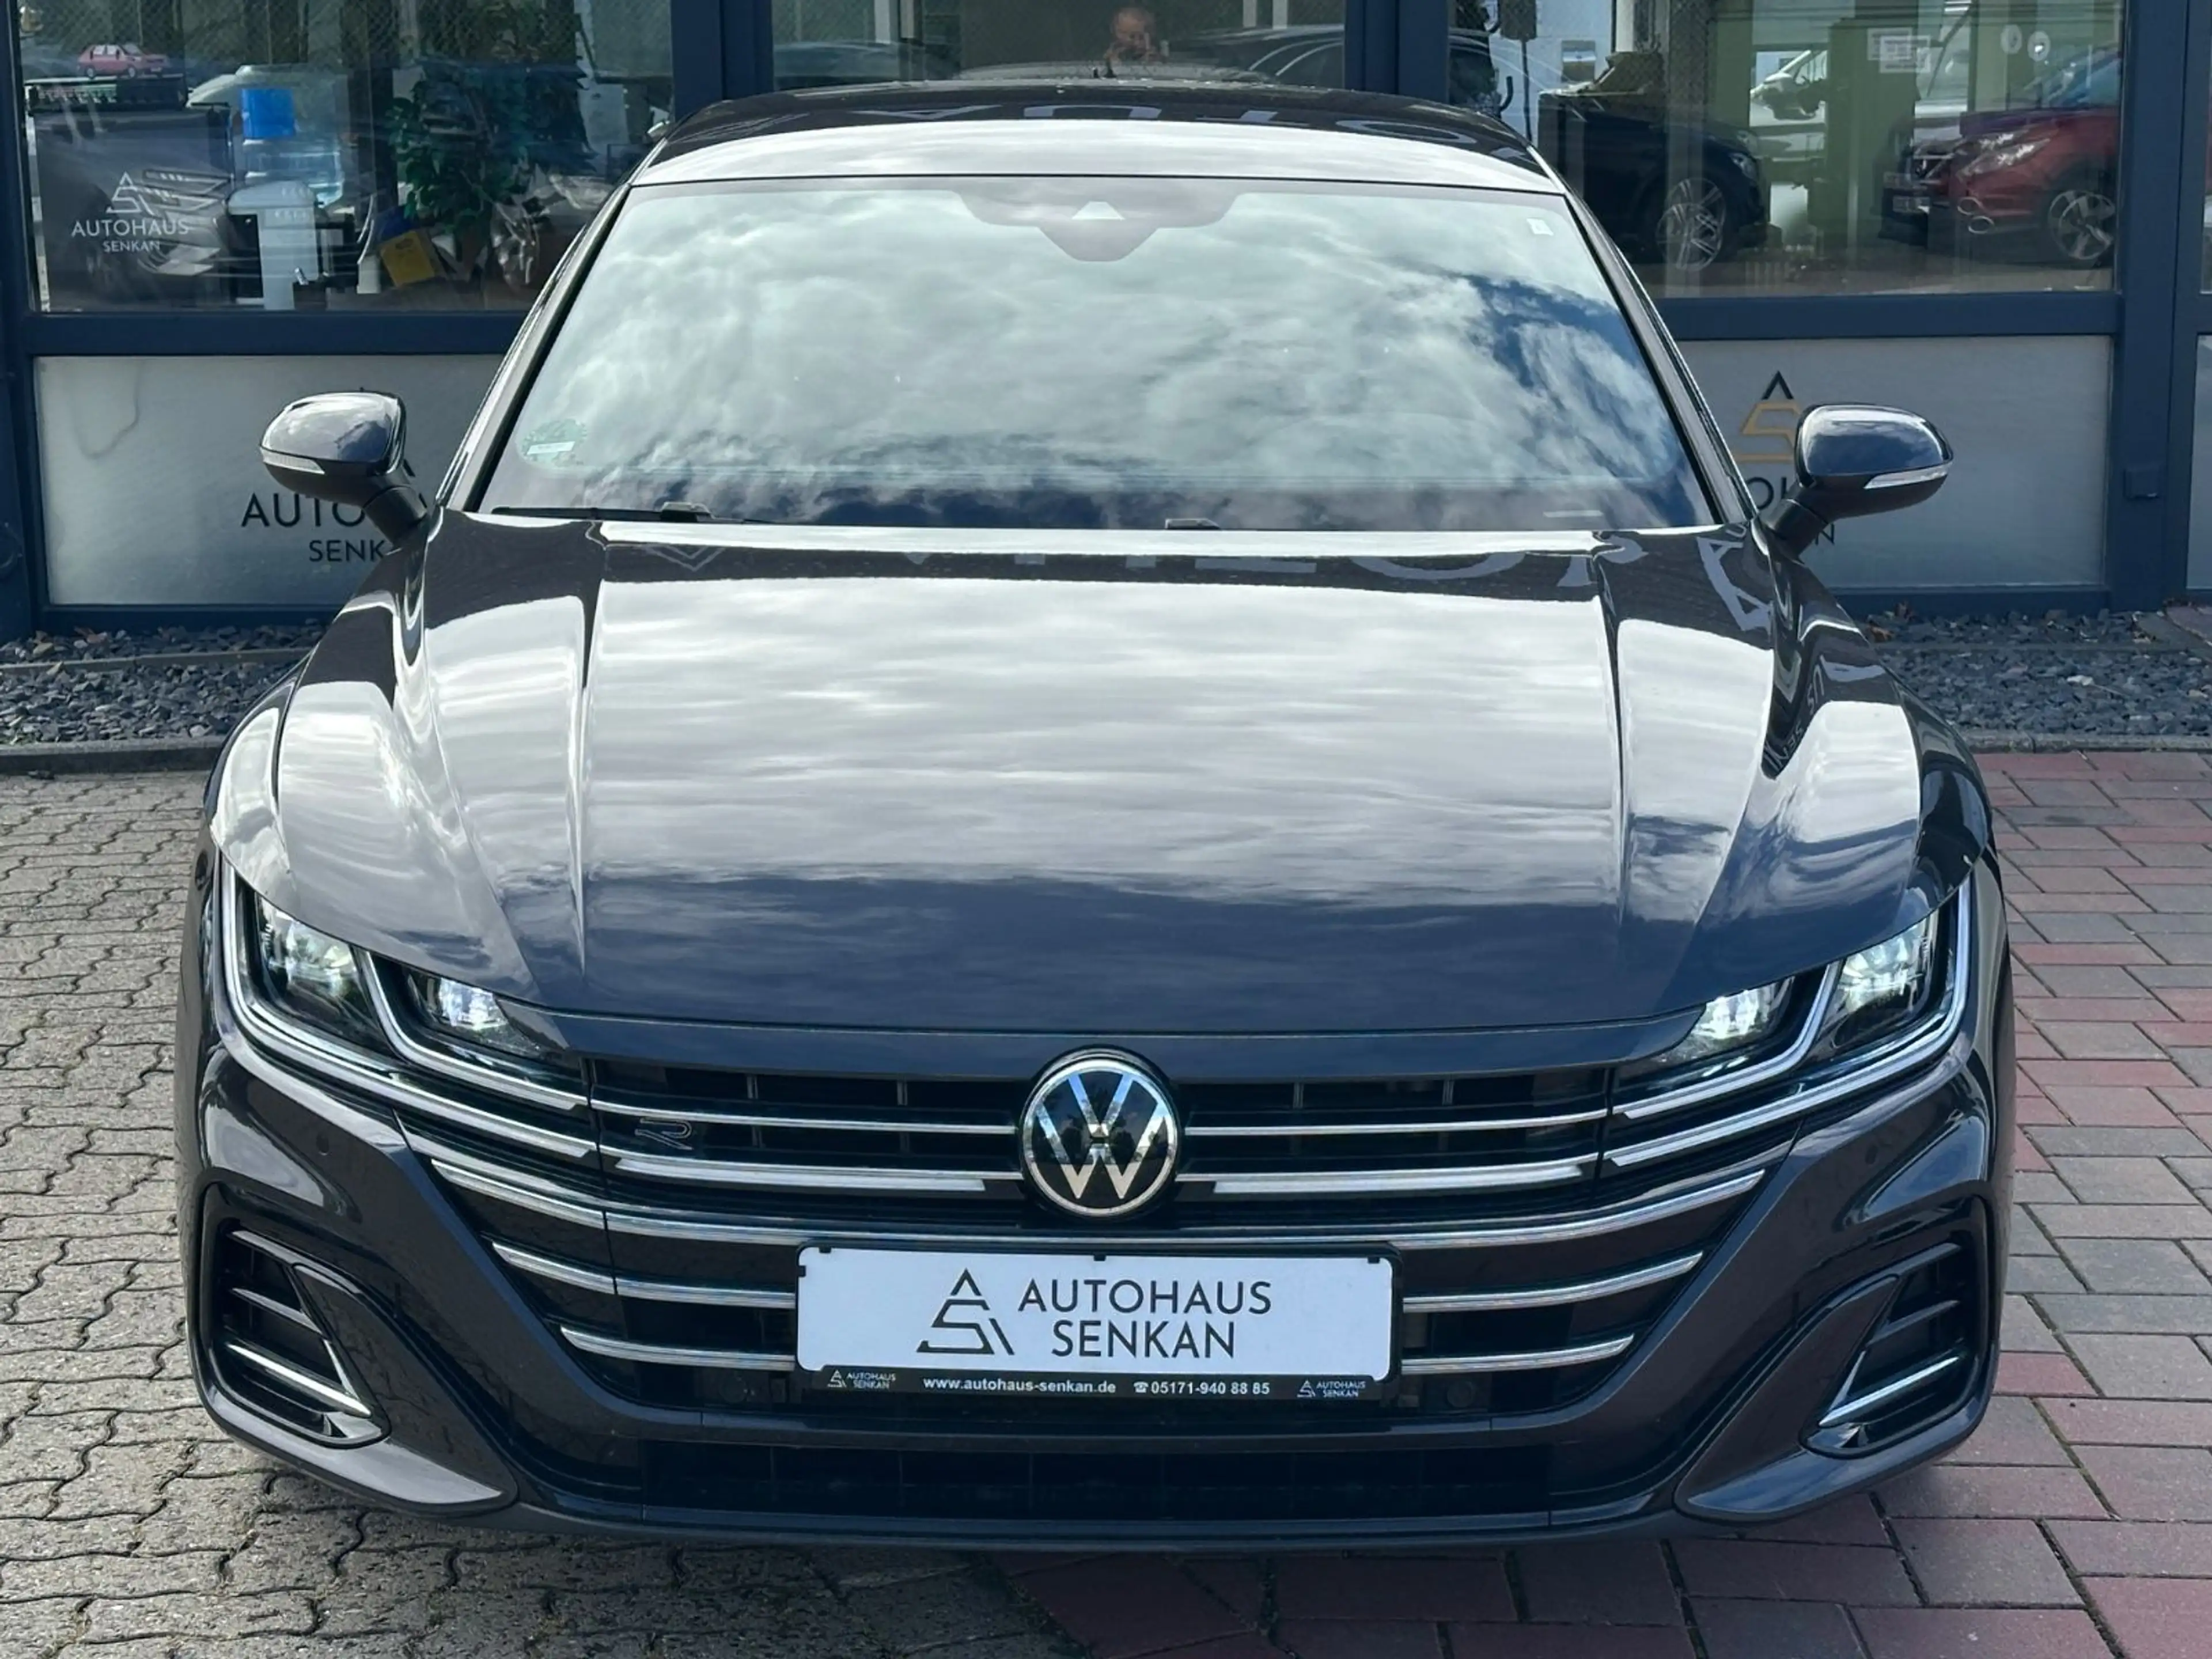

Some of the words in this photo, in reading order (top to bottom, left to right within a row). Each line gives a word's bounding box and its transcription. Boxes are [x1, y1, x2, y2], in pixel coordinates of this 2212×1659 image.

[71, 219, 189, 237] AUTOHAUS
[103, 240, 160, 253] SENKAN
[241, 493, 365, 528] AUTO
[309, 540, 385, 562] SENK
[1035, 1070, 1167, 1200] VW
[1017, 1278, 1272, 1315] AUTOHAUS
[1051, 1320, 1234, 1359] SENKAN
[847, 1372, 896, 1381] AUTOHAUS
[853, 1380, 890, 1389] SENKAN
[923, 1377, 1116, 1393] www.autohaus-senkan.de
[1151, 1381, 1226, 1395] 05171-940
[1230, 1382, 1248, 1395] 88
[1252, 1382, 1270, 1395] 85
[1316, 1381, 1366, 1389] AUTOHAUS
[1323, 1389, 1359, 1397] SENKAN
